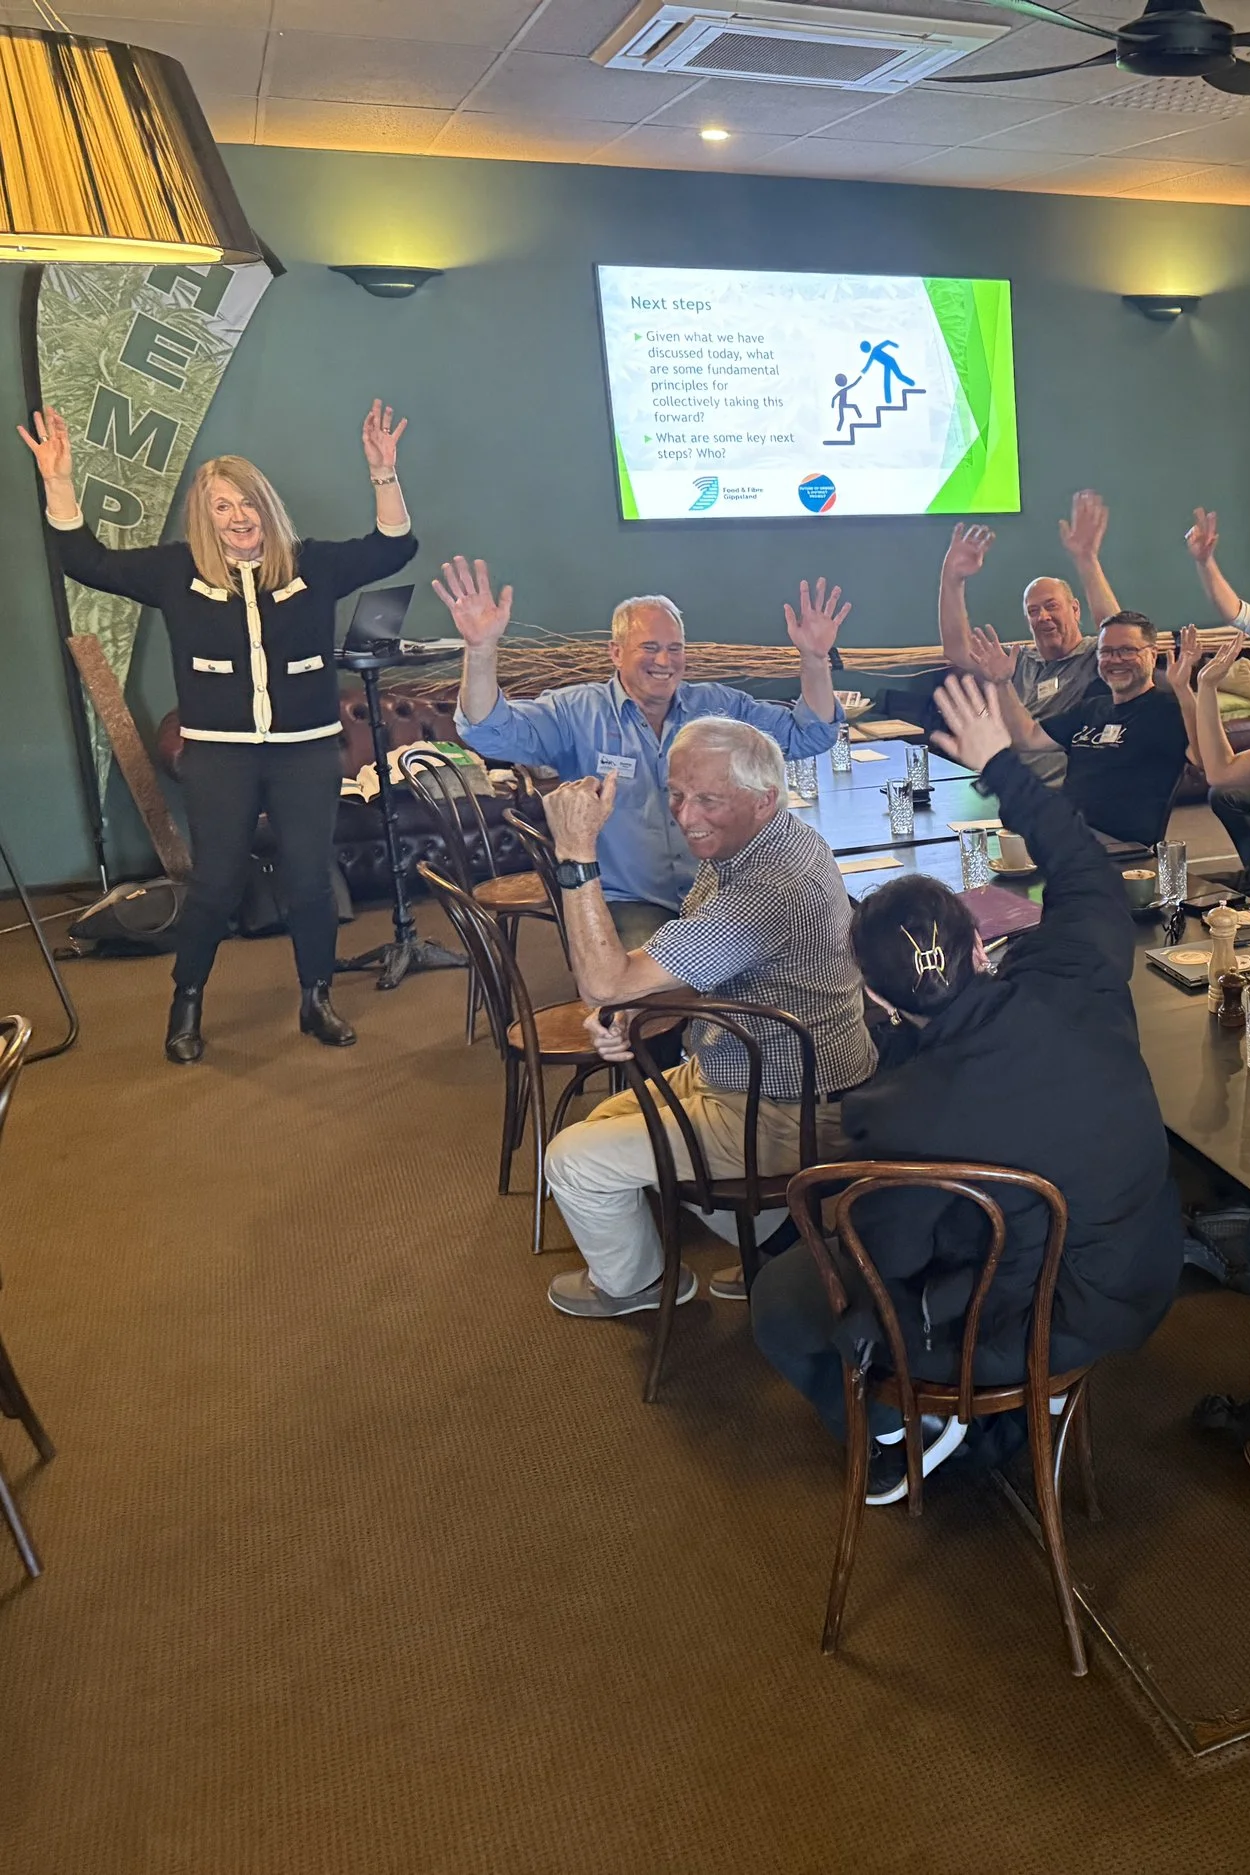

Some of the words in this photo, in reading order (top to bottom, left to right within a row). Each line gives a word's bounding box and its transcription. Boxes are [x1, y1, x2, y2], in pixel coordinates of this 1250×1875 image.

[631, 296, 667, 310] Next
[672, 298, 712, 314] steps
[646, 331, 680, 343] Given
[684, 332, 713, 343] what
[717, 334, 734, 343] we
[738, 332, 765, 344] have
[648, 348, 704, 359] discussed
[707, 349, 742, 362] today,
[747, 350, 774, 361] what
[649, 366, 669, 375] are
[673, 366, 703, 375] some
[707, 364, 779, 376] fundamental
[651, 380, 708, 393] principles
[712, 380, 729, 391] for
[653, 396, 720, 409] collectively
[724, 397, 760, 409] taking
[763, 397, 784, 408] this
[654, 411, 705, 423] forward?
[656, 432, 686, 443] What
[691, 434, 710, 443] are
[713, 434, 743, 443] some
[747, 432, 766, 446] key
[770, 433, 795, 443] next
[658, 448, 692, 461] steps?
[696, 448, 726, 459] Who?
